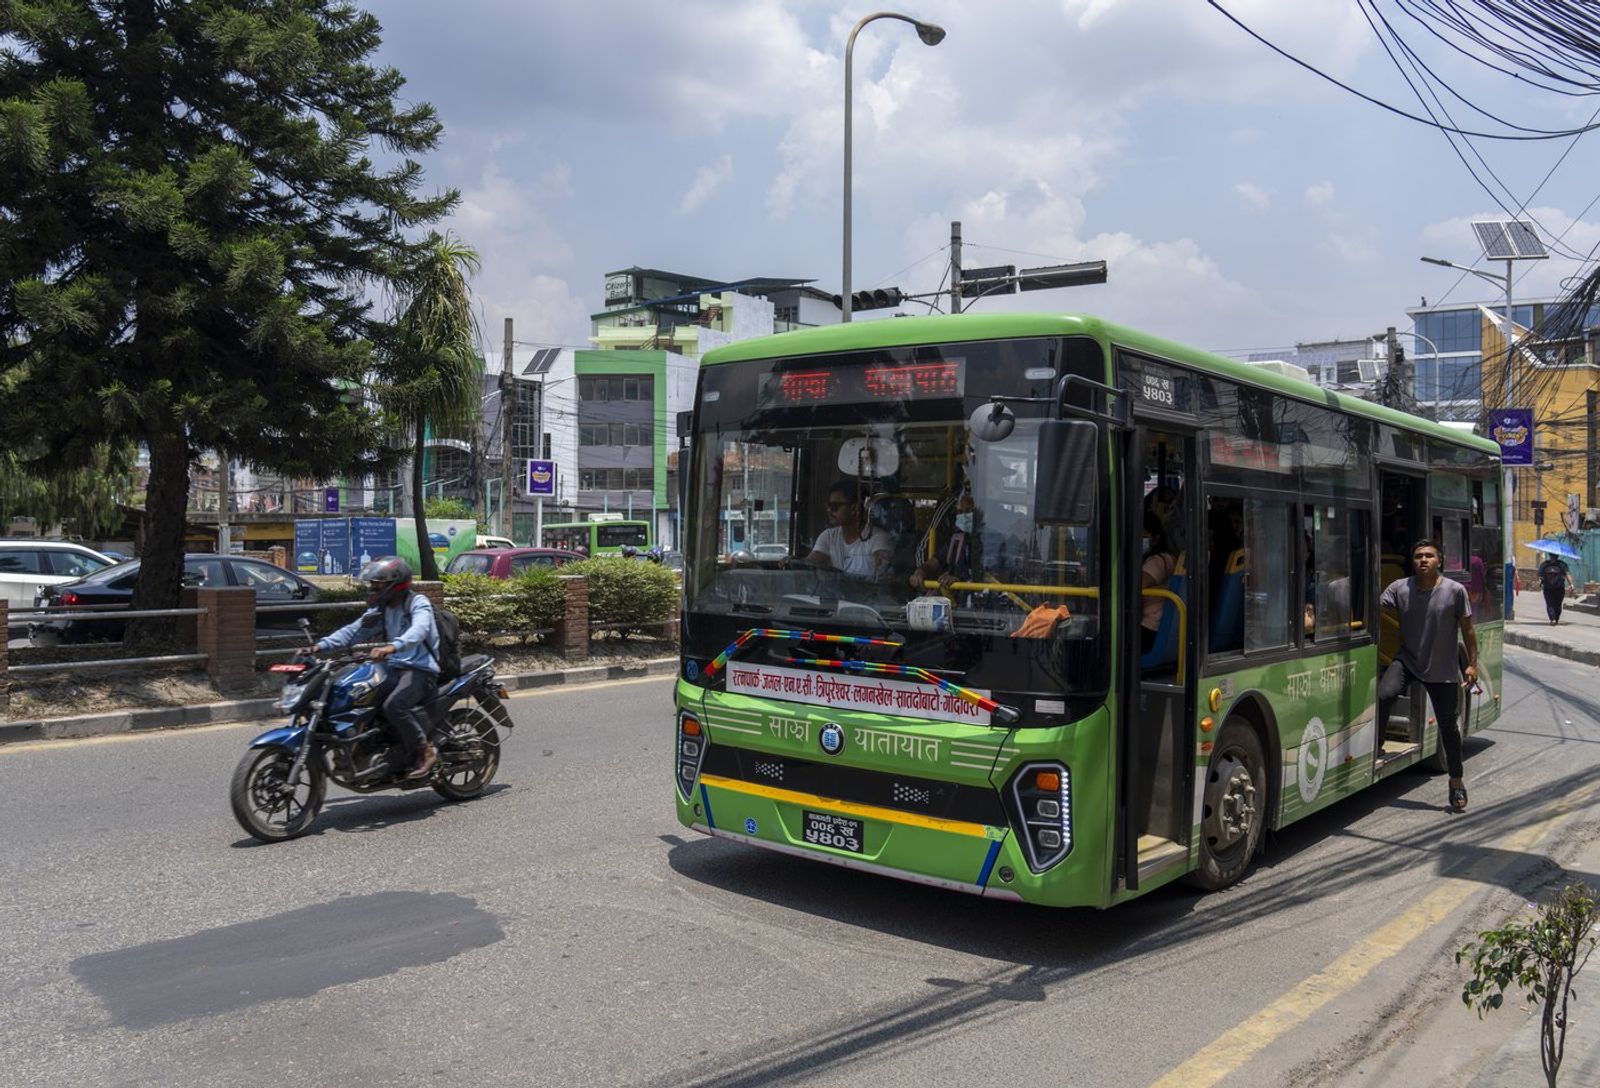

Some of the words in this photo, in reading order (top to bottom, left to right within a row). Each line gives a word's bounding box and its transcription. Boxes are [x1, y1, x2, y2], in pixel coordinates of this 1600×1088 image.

[1143, 386, 1172, 405] ५४०३
[762, 674, 781, 692] जमल
[853, 682, 893, 706] लगनखेल
[769, 716, 812, 742] साझा
[855, 728, 942, 762] यातायात
[811, 820, 836, 835] ००६
[840, 826, 855, 837] ख
[805, 829, 860, 851] ५४०३
